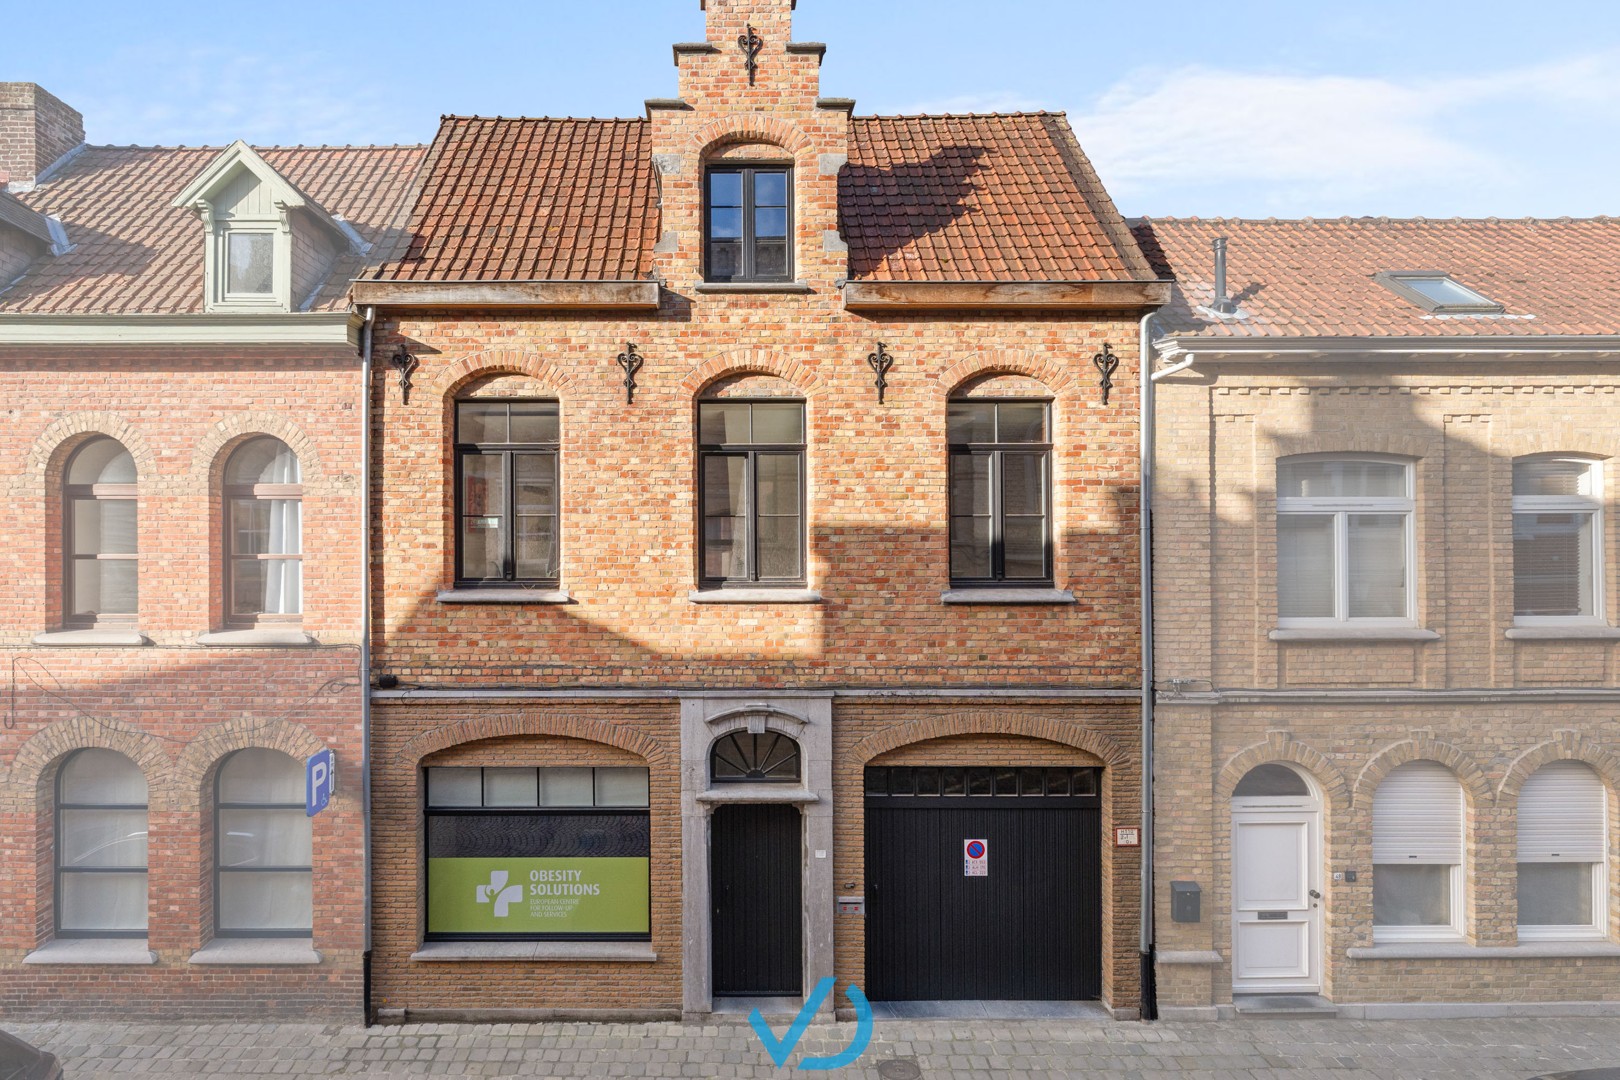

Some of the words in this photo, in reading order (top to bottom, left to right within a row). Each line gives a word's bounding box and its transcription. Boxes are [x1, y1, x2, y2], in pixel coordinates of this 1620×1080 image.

[311, 761, 327, 807] P
[530, 869, 582, 881] OBESITY
[530, 884, 600, 896] SOLUTIONS
